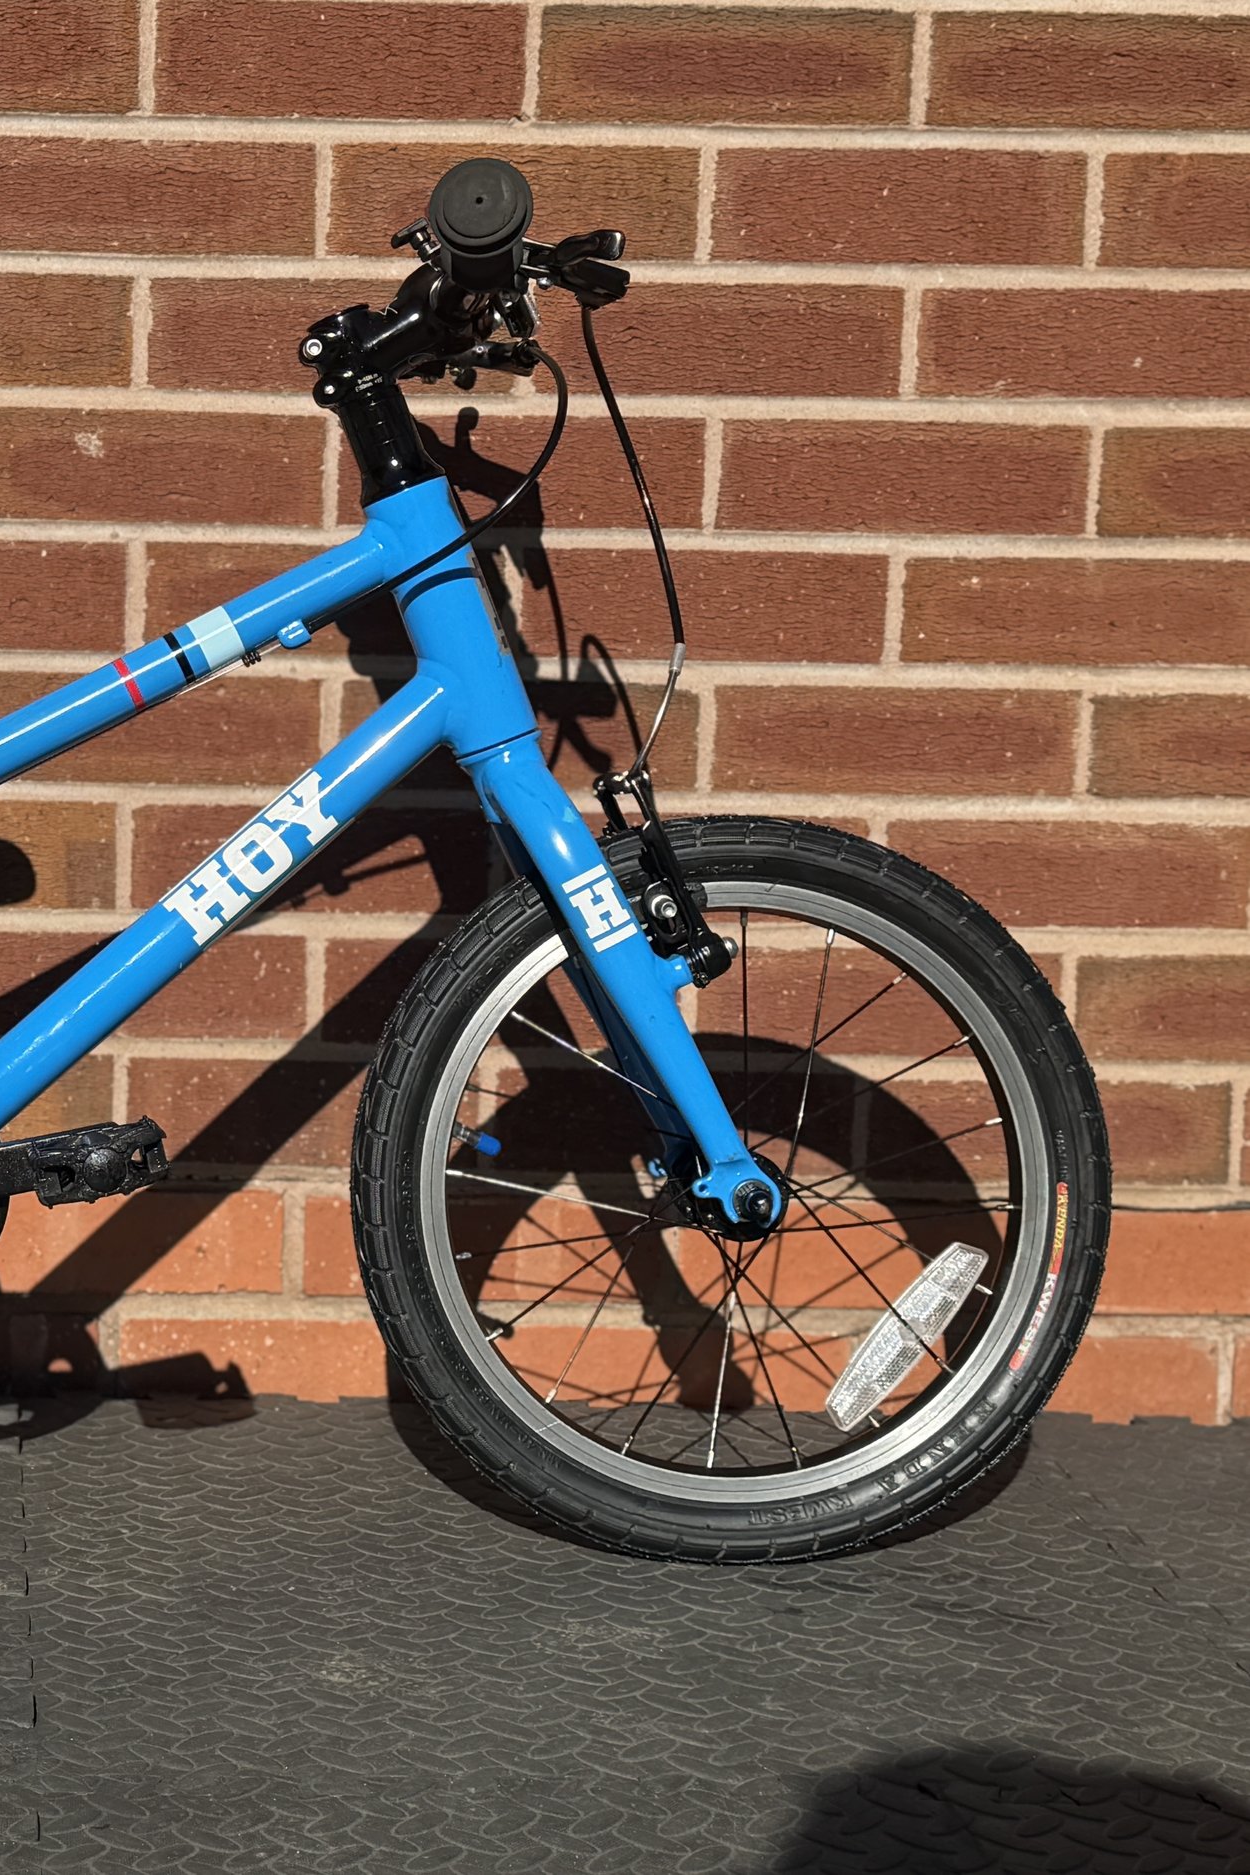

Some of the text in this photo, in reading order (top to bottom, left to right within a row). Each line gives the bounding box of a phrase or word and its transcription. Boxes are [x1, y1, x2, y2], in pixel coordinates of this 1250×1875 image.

[162, 770, 338, 946] HOY
[1053, 1193, 1069, 1251] KENDA
[1017, 1272, 1058, 1357] KWEST
[748, 1492, 855, 1527] KWEST
